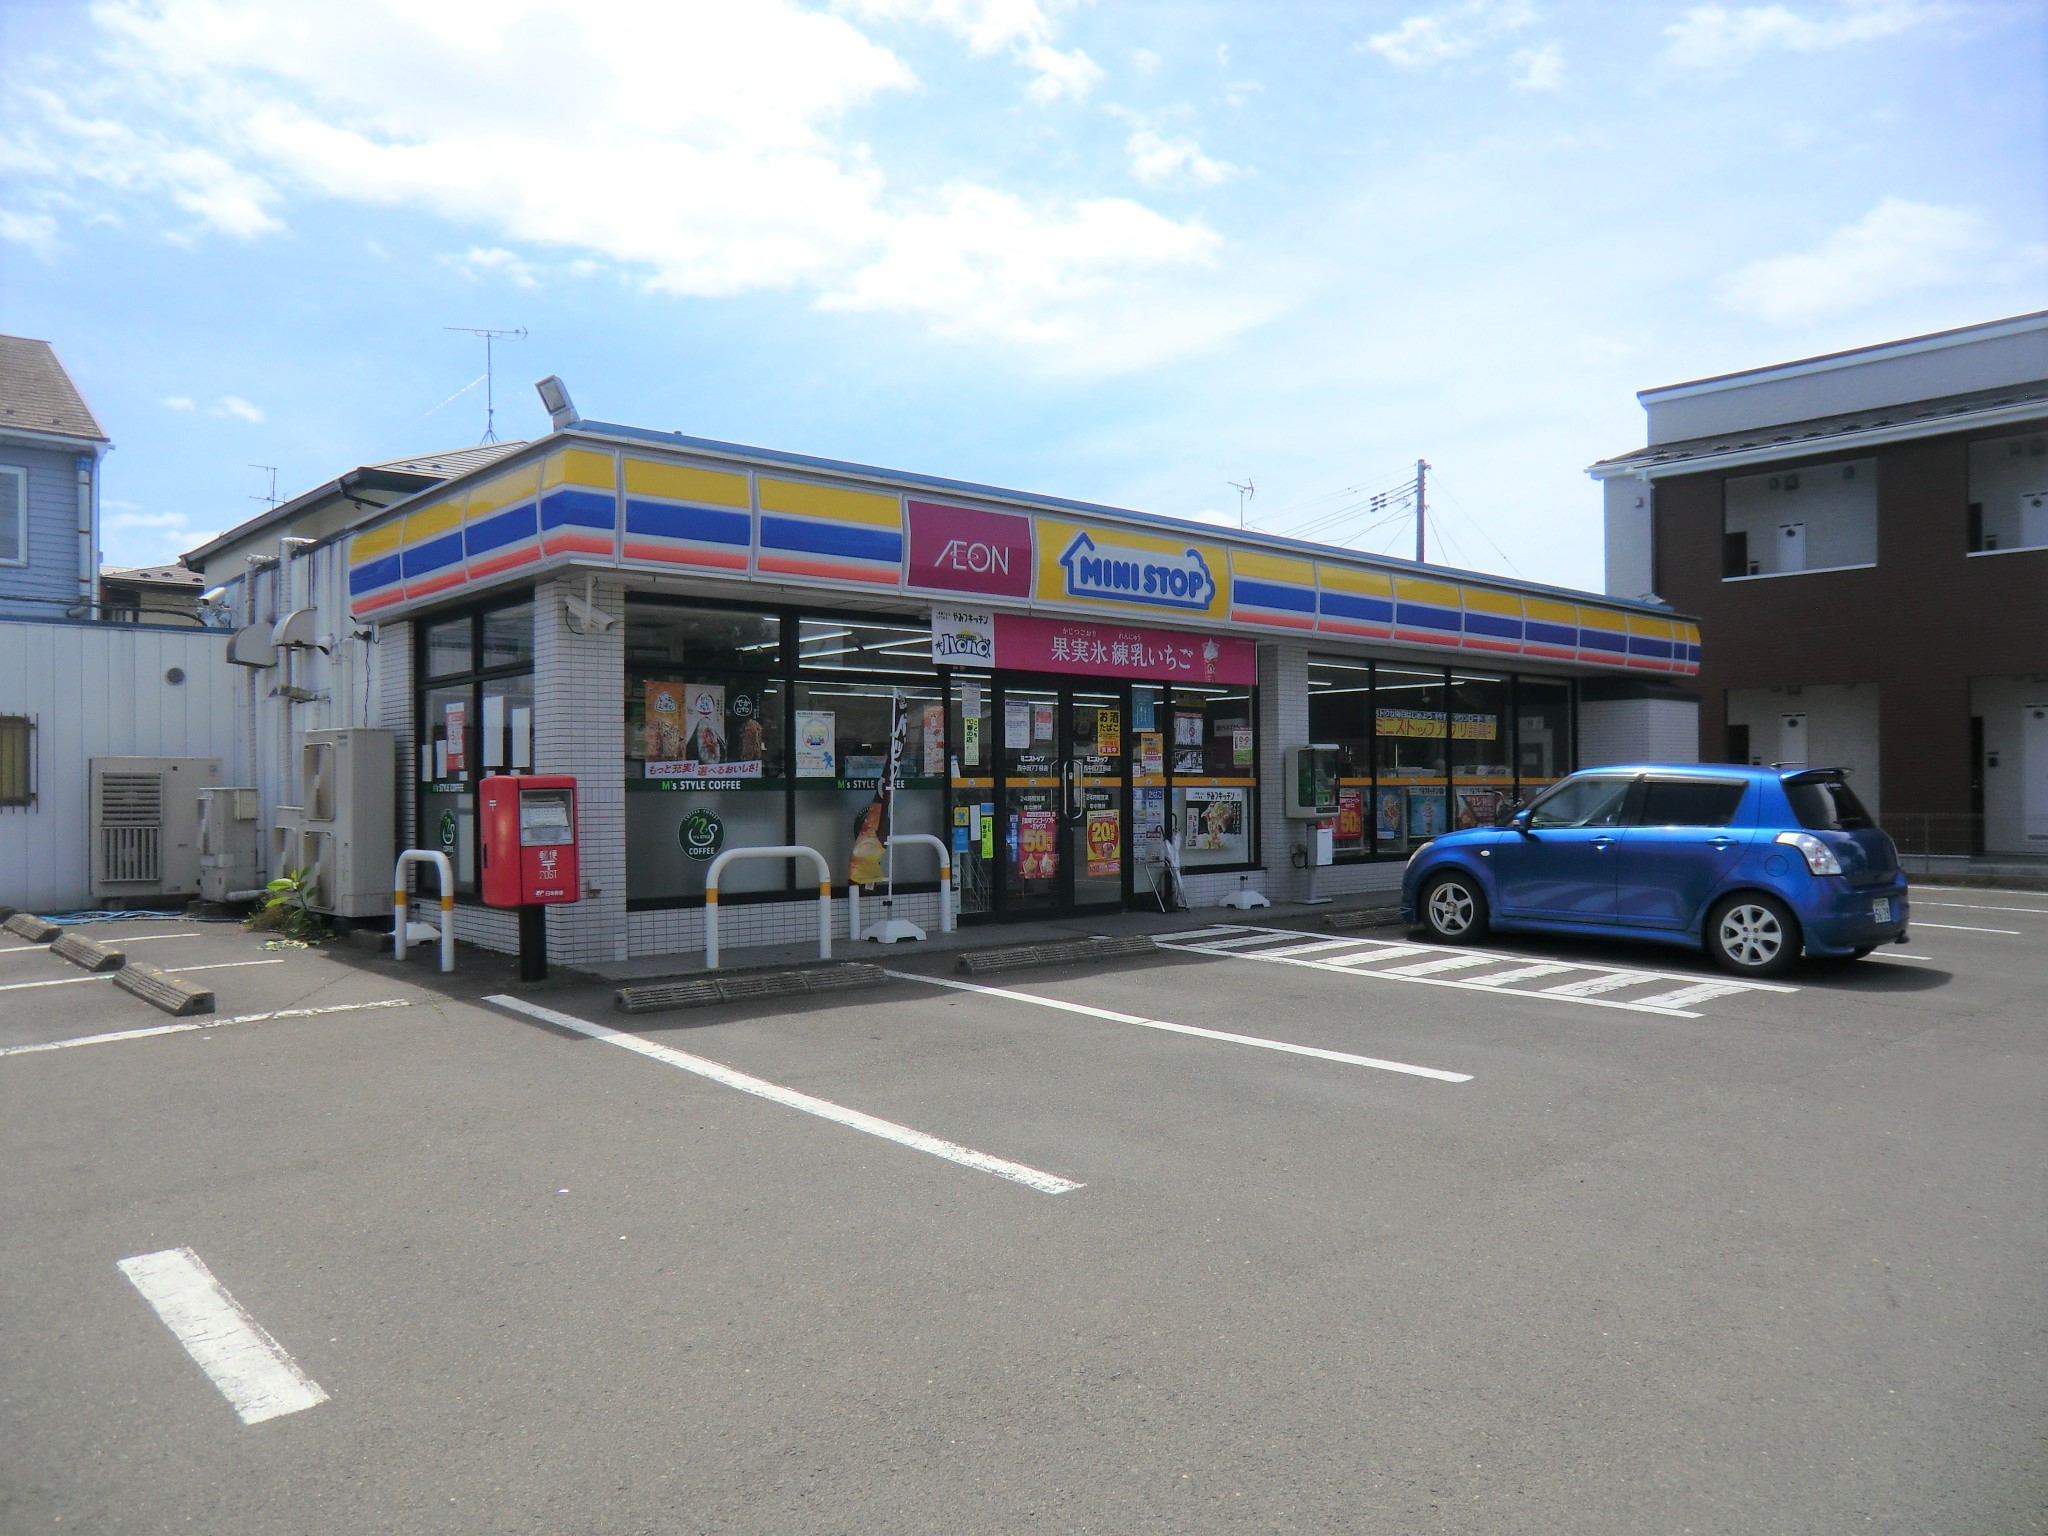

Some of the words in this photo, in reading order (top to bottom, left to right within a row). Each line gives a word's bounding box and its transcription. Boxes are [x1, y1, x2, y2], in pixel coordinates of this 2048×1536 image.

[1080, 555, 1140, 591] MINI
[1143, 567, 1204, 599] STOP
[1062, 627, 1097, 637] かじつこおり
[1118, 632, 1142, 642] れんにゅう
[1099, 724, 1120, 732] たばこ
[1020, 755, 1046, 763] ミニストップ
[1086, 755, 1109, 763] ミニストップ
[439, 783, 450, 792] STYLE
[661, 780, 677, 790] M's
[680, 780, 706, 790] STYLE
[708, 780, 741, 790] COFFEE
[837, 780, 850, 789] M's
[853, 780, 875, 789] STYLE
[1091, 822, 1110, 842] 20
[1022, 829, 1046, 853] 50
[688, 847, 715, 855] COFFEE
[539, 869, 558, 880] POST
